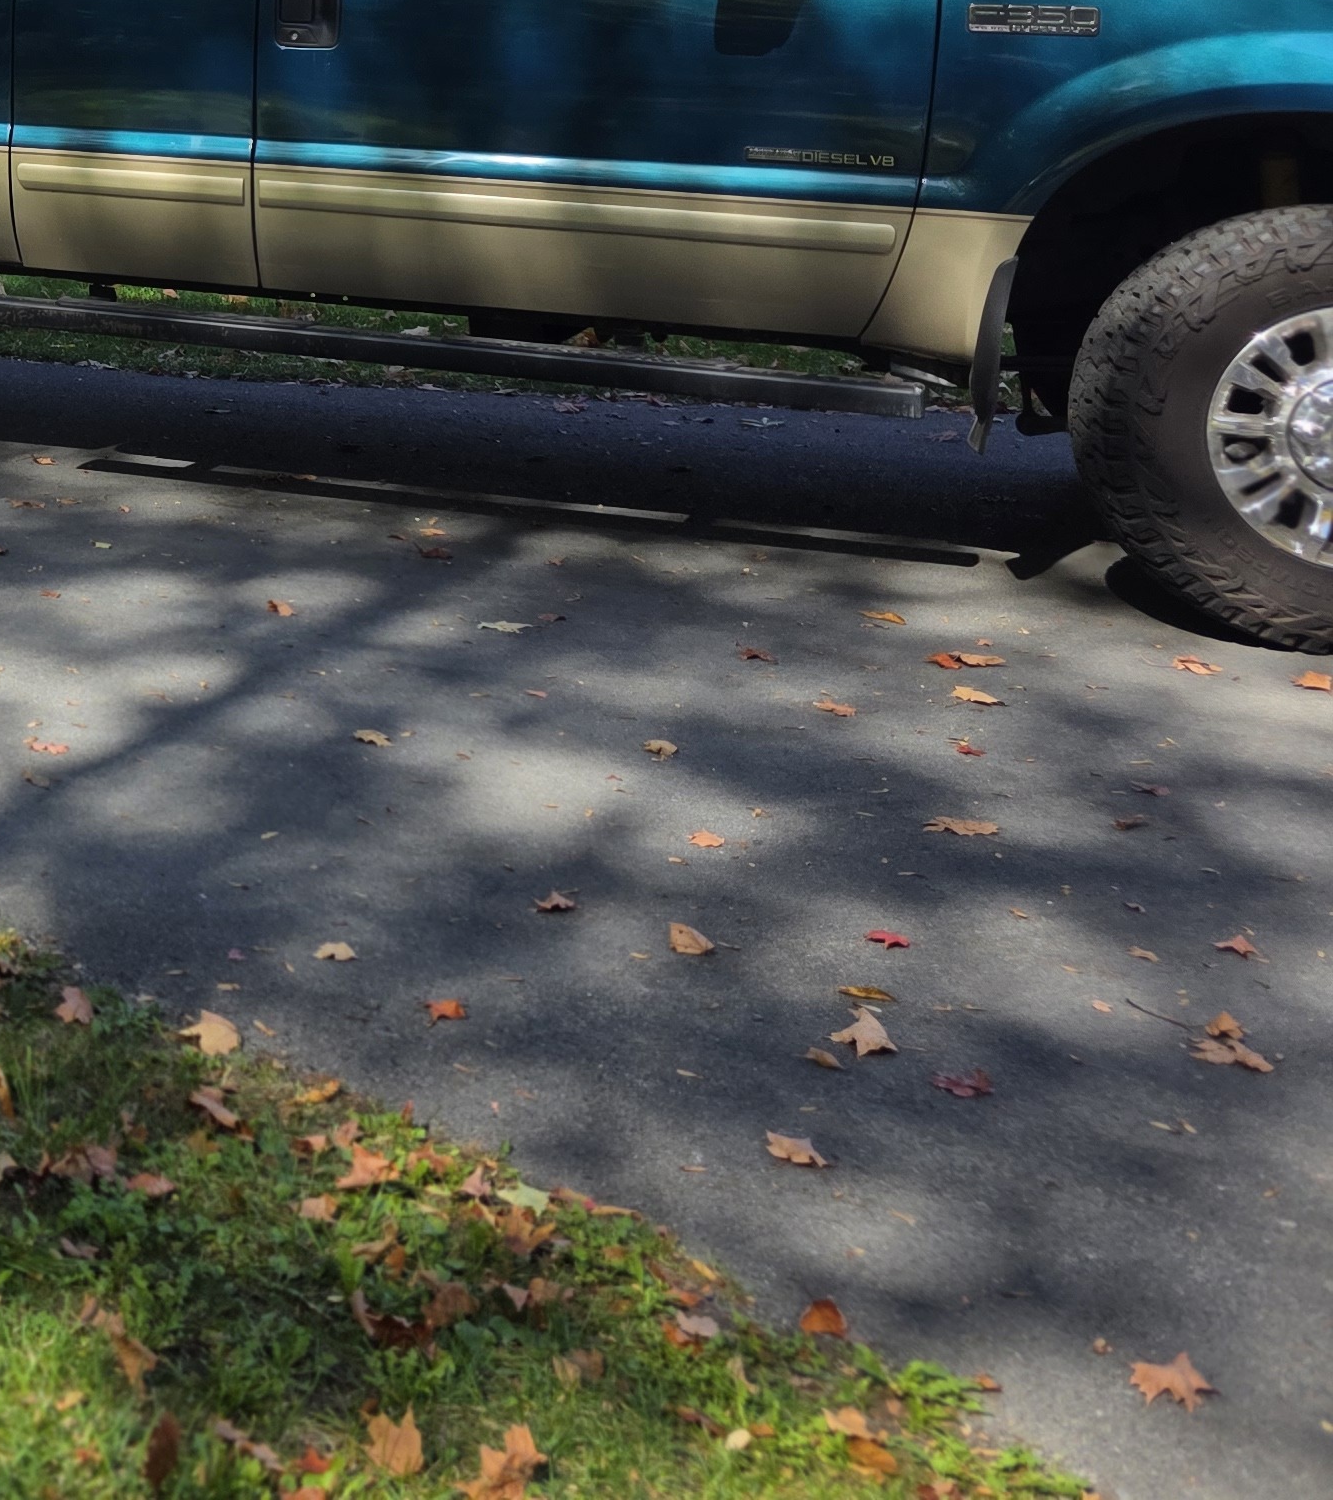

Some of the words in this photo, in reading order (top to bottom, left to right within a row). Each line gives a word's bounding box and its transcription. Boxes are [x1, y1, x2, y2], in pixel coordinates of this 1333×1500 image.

[968, 2, 1099, 25] F-350
[802, 151, 868, 165] DIESEL
[870, 155, 895, 166] V8
